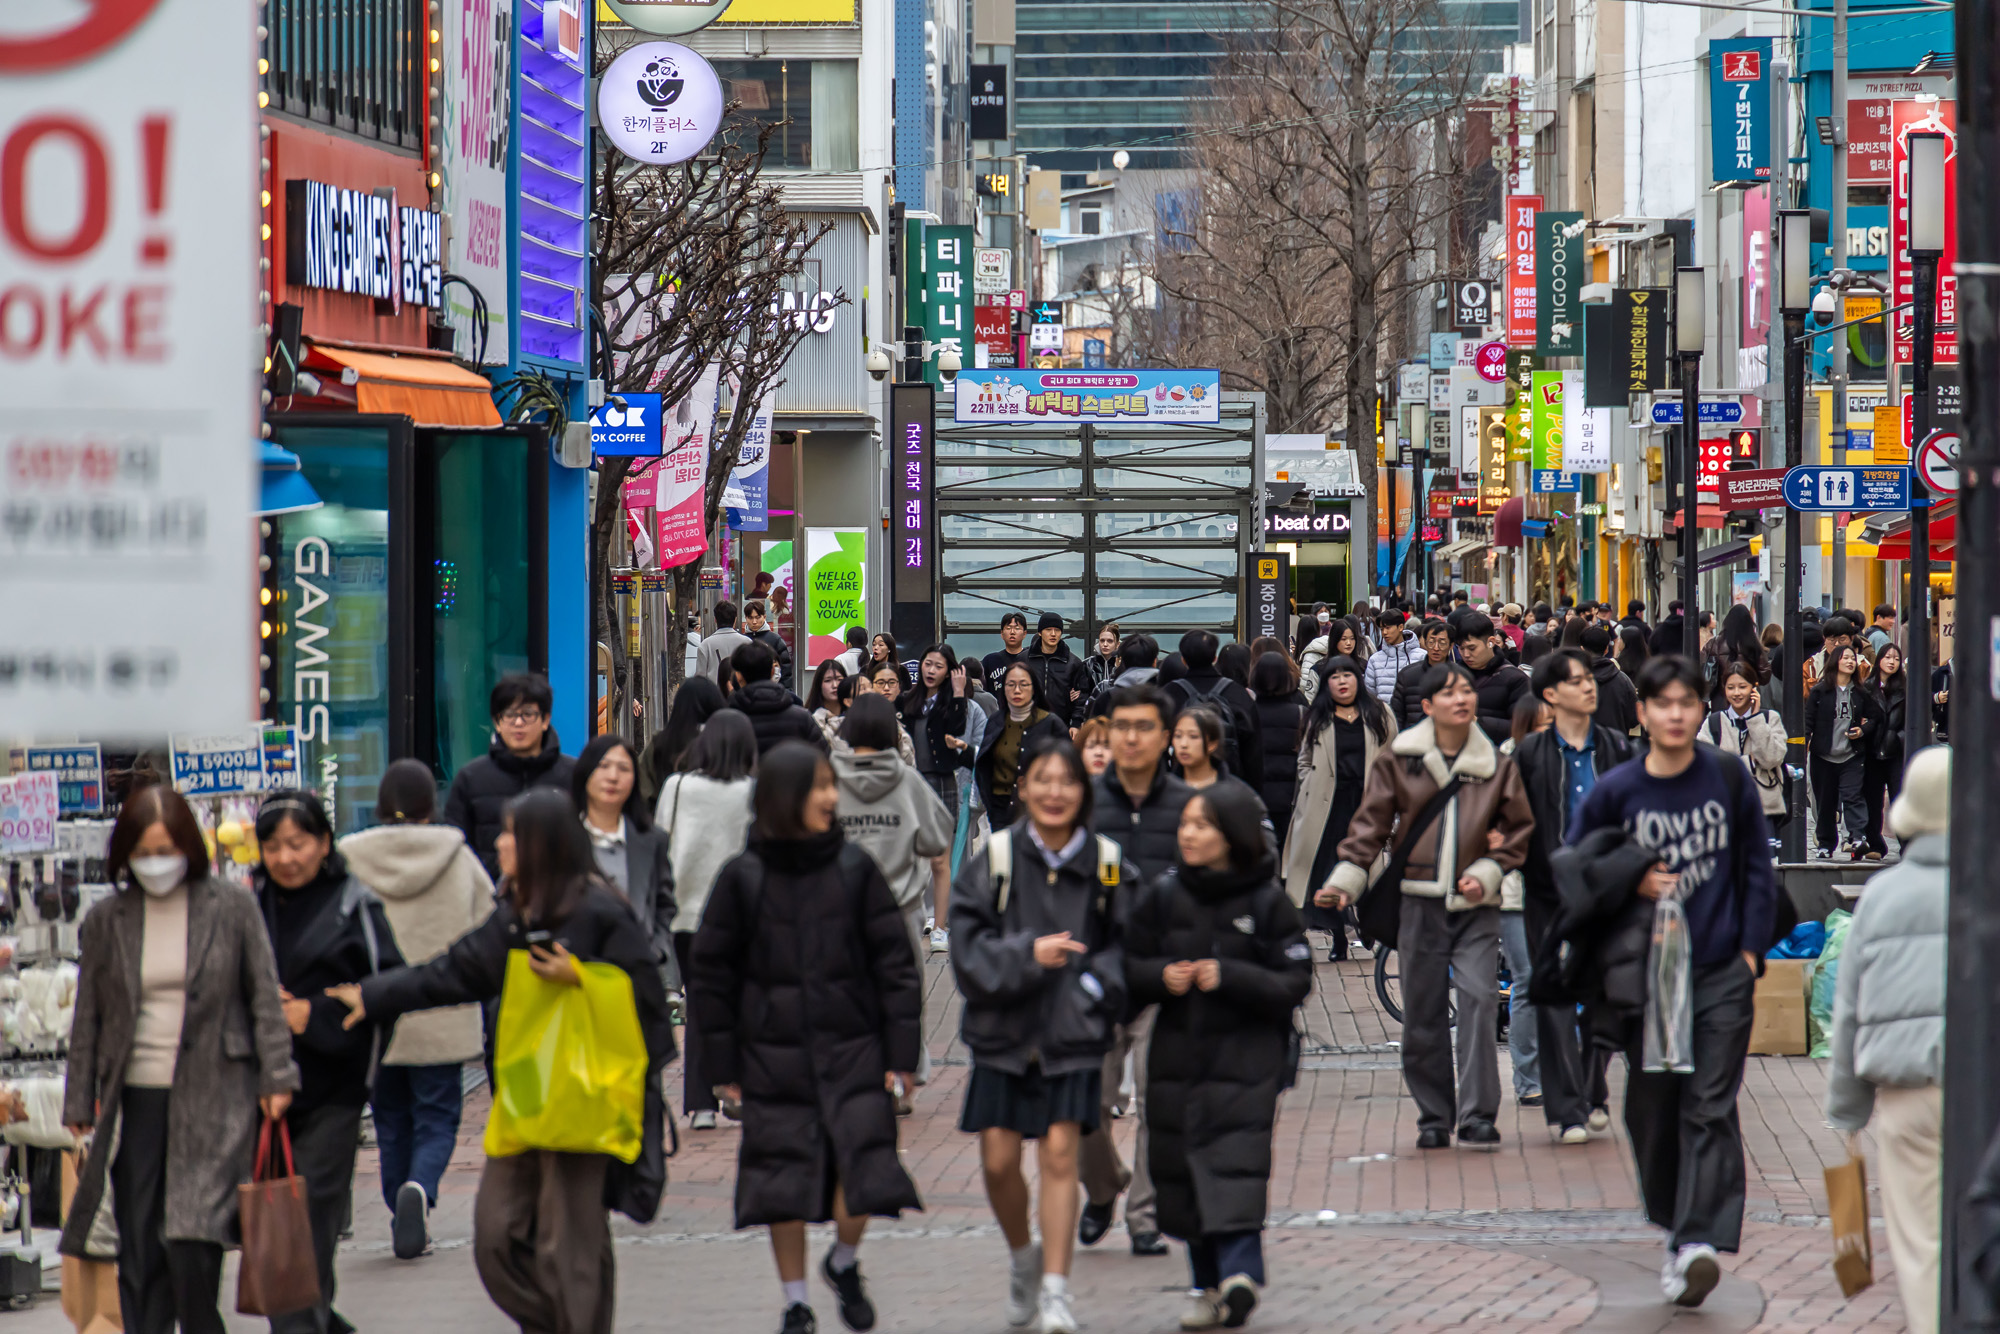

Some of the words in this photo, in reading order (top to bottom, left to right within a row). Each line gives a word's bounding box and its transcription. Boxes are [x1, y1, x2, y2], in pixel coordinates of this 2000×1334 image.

[1879, 83, 1904, 93] STREET
[1904, 82, 1923, 92] PIZZA
[1865, 106, 1885, 118] 1인용
[622, 116, 698, 133] 한끼플러스
[1735, 83, 1754, 169] 7번가피자
[650, 141, 669, 154] 2F
[1516, 207, 1535, 276] 제이원
[981, 253, 1001, 263] CCR
[1552, 220, 1566, 333] CROCODIL
[1629, 305, 1649, 390] 한국공인금거래소
[970, 402, 995, 414] 22개
[997, 402, 1019, 414] 상점
[1028, 391, 1081, 415] 캐릭터
[1083, 393, 1148, 416] 스트리트
[1655, 409, 1667, 417] 591
[1726, 408, 1739, 417] 595
[1581, 390, 1594, 454] 사밀라
[608, 433, 646, 443] COFFEE
[906, 423, 922, 454] 굿즈
[1491, 437, 1506, 482] 럭셔리
[906, 461, 922, 491] 천국
[1539, 471, 1574, 491] 폼프
[1862, 471, 1900, 480] 개방화장실
[1728, 478, 1784, 494] 동성로관광특
[906, 500, 922, 529] 레어
[1274, 514, 1310, 531] beat
[1313, 514, 1330, 531] of
[817, 571, 856, 580] HELLO
[814, 581, 834, 591] WE
[836, 581, 859, 591] ARE
[819, 599, 854, 609] OLIVE
[816, 609, 859, 619] YOUNG
[295, 536, 330, 745] GAMES
[177, 756, 199, 772] 1개
[203, 750, 259, 769] 5900원
[188, 772, 214, 789] 2개
